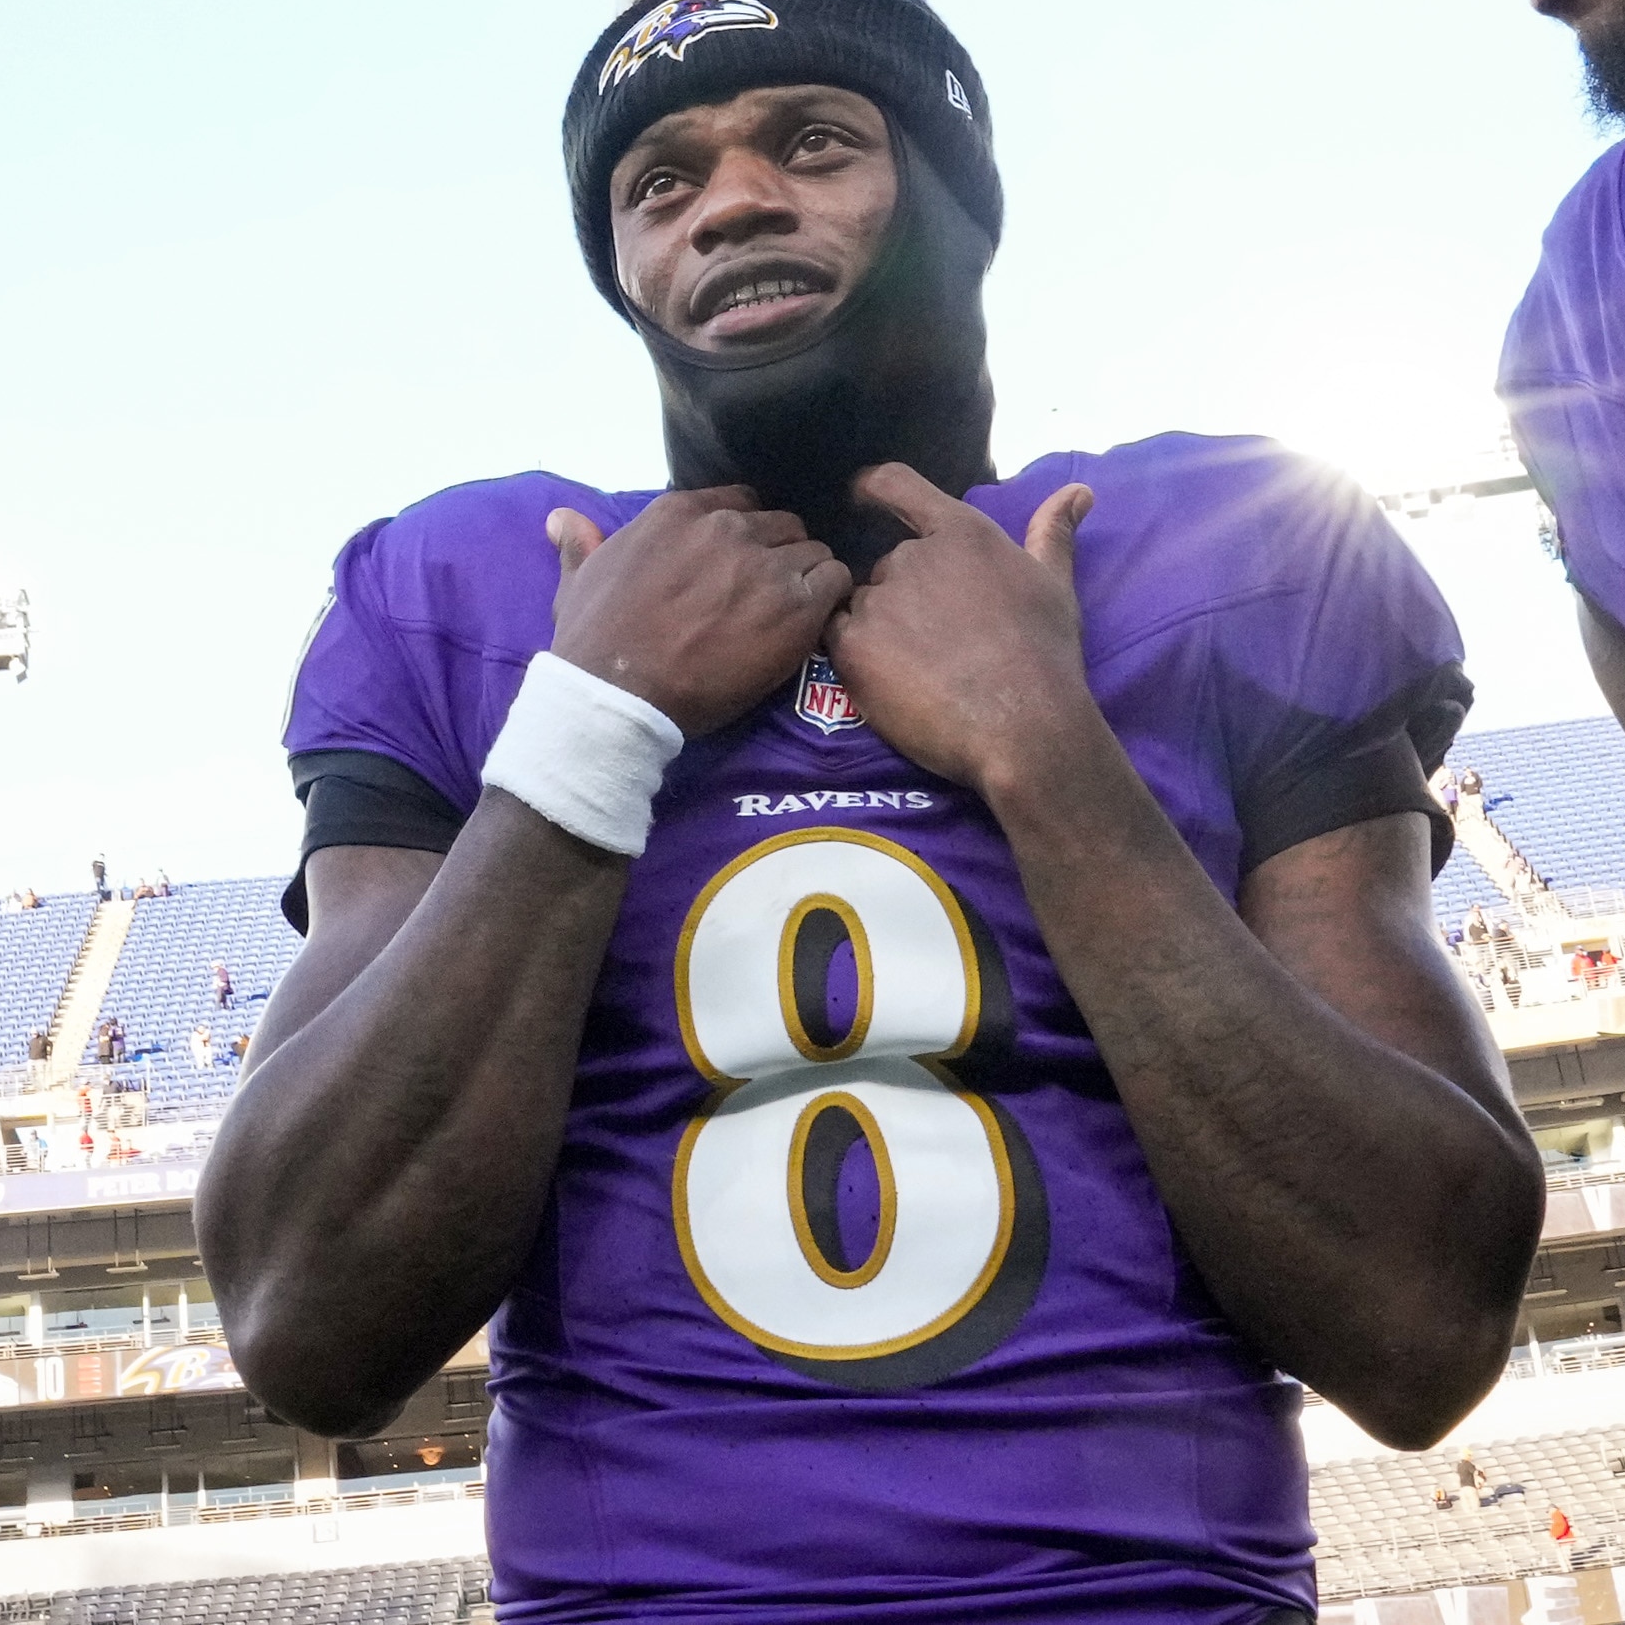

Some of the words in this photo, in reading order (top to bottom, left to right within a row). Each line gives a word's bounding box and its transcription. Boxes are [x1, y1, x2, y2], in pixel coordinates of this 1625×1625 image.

[731, 790, 934, 817] RAVENS
[672, 827, 1020, 1365] 8
[87, 1172, 163, 1198] PETER
[33, 1356, 65, 1401] 10
